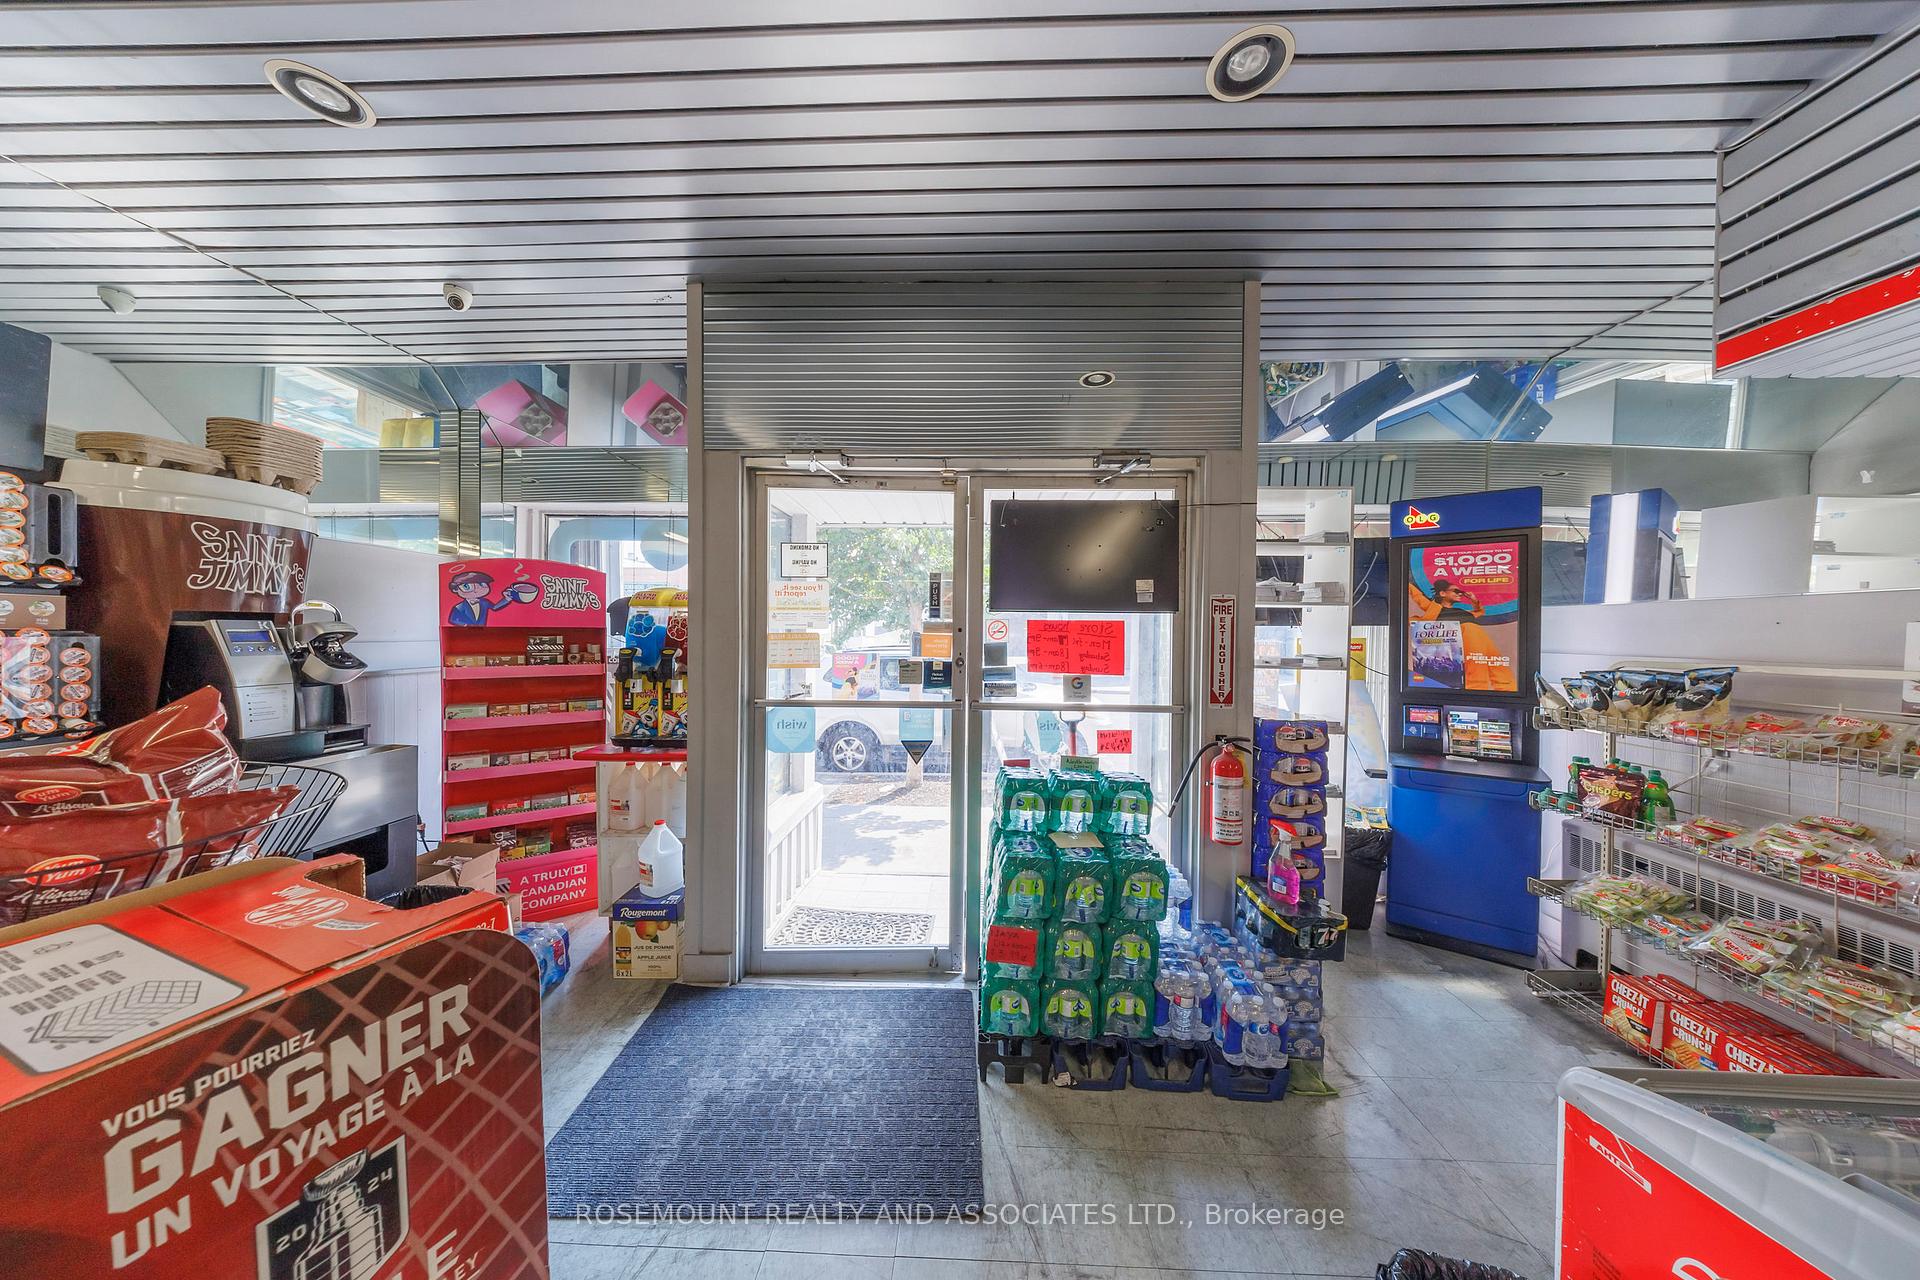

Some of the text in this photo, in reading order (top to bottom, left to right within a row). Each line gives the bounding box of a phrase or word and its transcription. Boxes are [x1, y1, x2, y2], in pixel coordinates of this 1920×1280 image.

[1405, 512, 1439, 524] OLG
[191, 521, 294, 563] SAINT
[187, 558, 305, 598] JIMMY'S
[1433, 565, 1512, 577] A WEEK
[541, 575, 588, 596] SAINT
[541, 592, 600, 611] JIMMY'S
[1213, 605, 1233, 615] FIRE
[1415, 629, 1458, 639] FOR LIFE
[1423, 622, 1445, 631] Cash
[1218, 616, 1226, 698] EXTINGUISHER
[29, 788, 60, 799] Yum
[1583, 780, 1633, 800] Crispers
[520, 867, 571, 886] A TRULY
[521, 876, 587, 898] CANADIAN
[522, 888, 587, 911] COMPANY
[620, 907, 667, 918] Rougemont
[1611, 994, 1643, 1020] CRUNCH
[1672, 1025, 1713, 1055] CRUNCH
[101, 1028, 316, 1138] VOUS POURRIEZ
[104, 983, 471, 1215] GAGNER
[111, 1043, 475, 1271] UN VOYAGE À LA
[276, 1167, 393, 1254] 20 24
